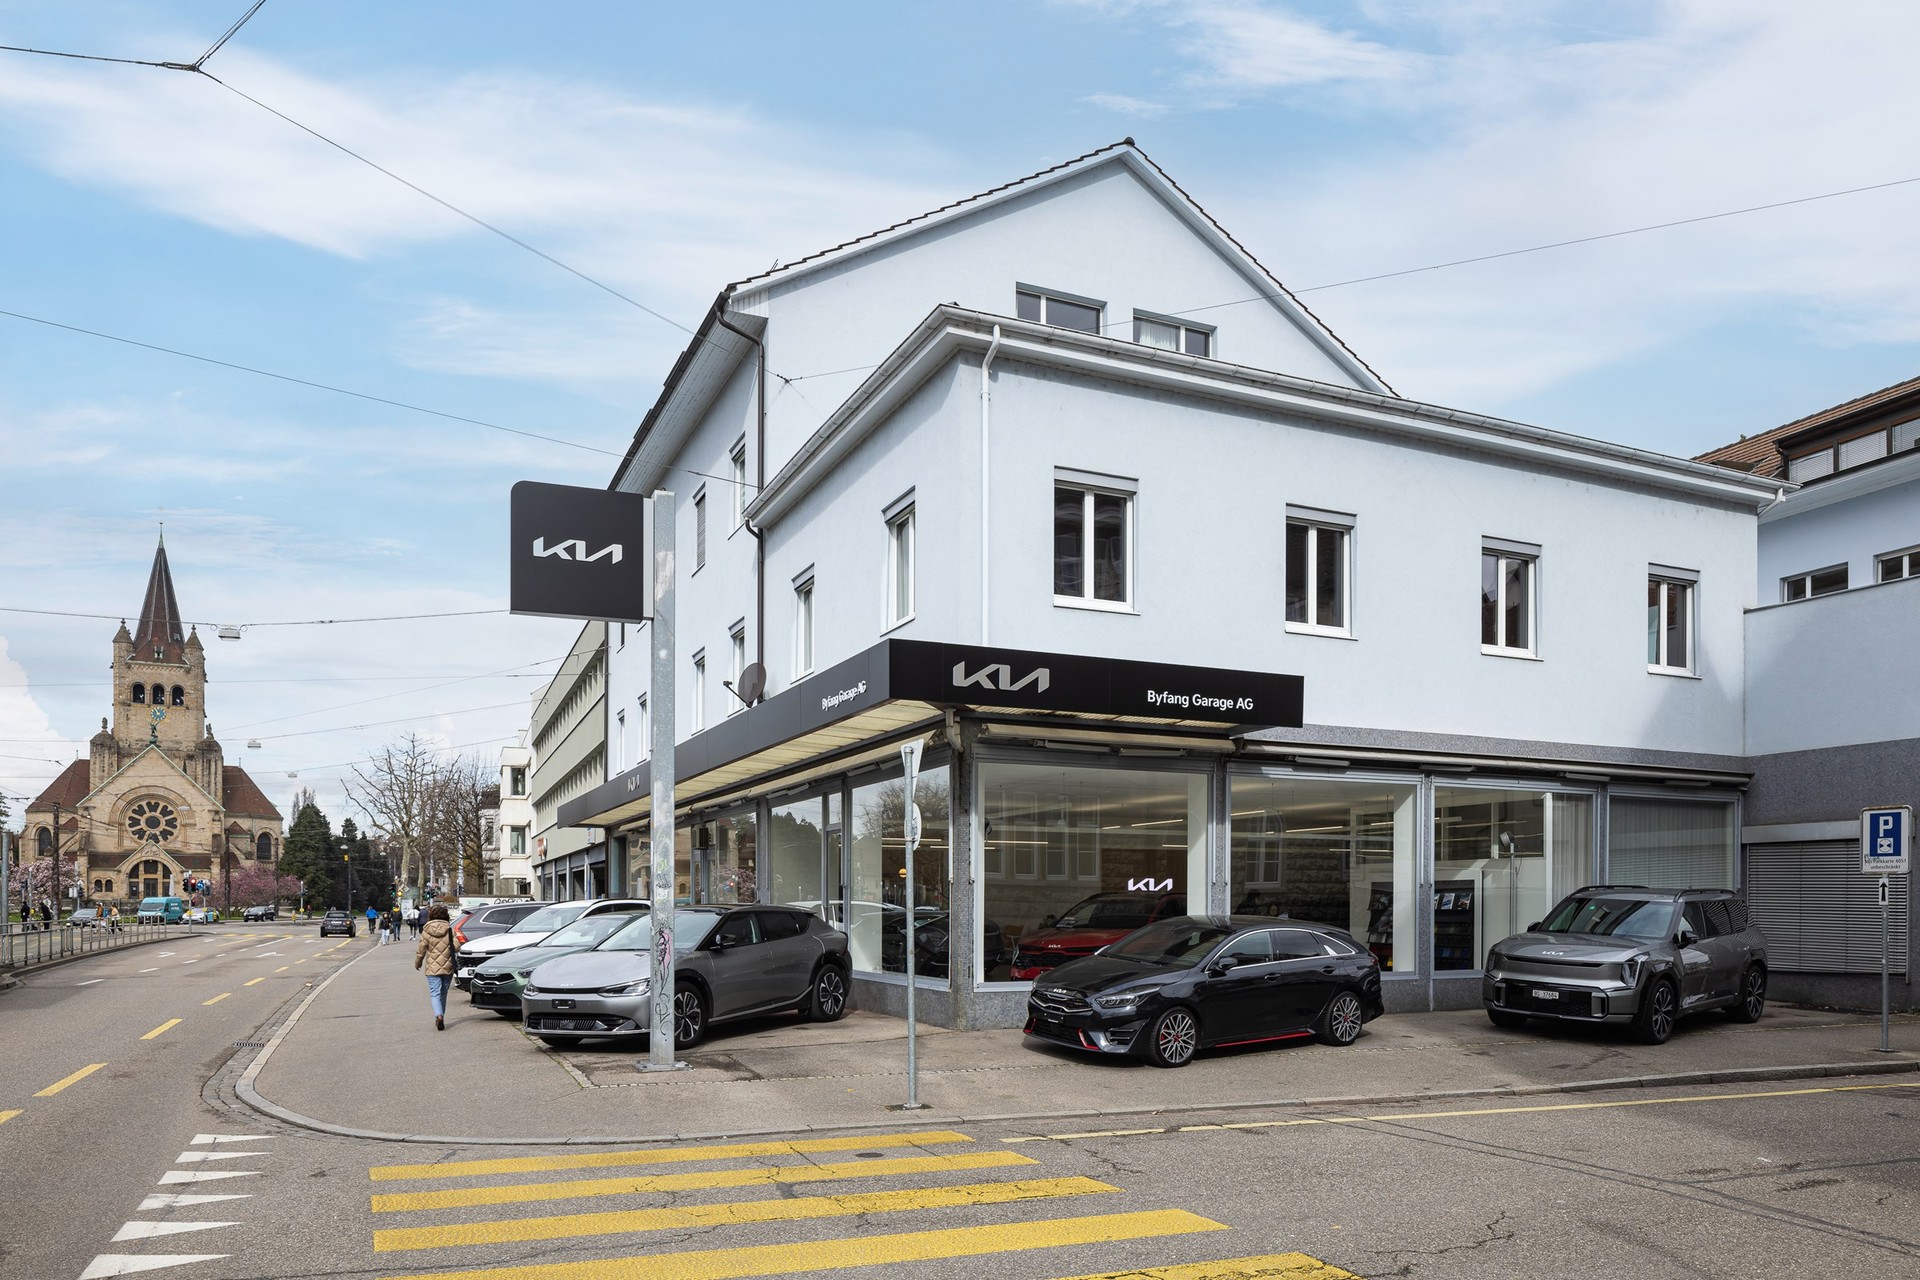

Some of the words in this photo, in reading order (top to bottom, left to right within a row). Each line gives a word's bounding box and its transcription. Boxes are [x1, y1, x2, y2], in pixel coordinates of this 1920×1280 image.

[533, 536, 623, 565] KIA
[953, 661, 1050, 694] KIA
[839, 687, 858, 702] Garage
[858, 680, 867, 694] AG
[1147, 689, 1190, 708] Byfang
[1192, 693, 1234, 711] Garage
[1236, 697, 1254, 710] AG
[1880, 816, 1893, 837] P
[1128, 877, 1173, 892] KIA
